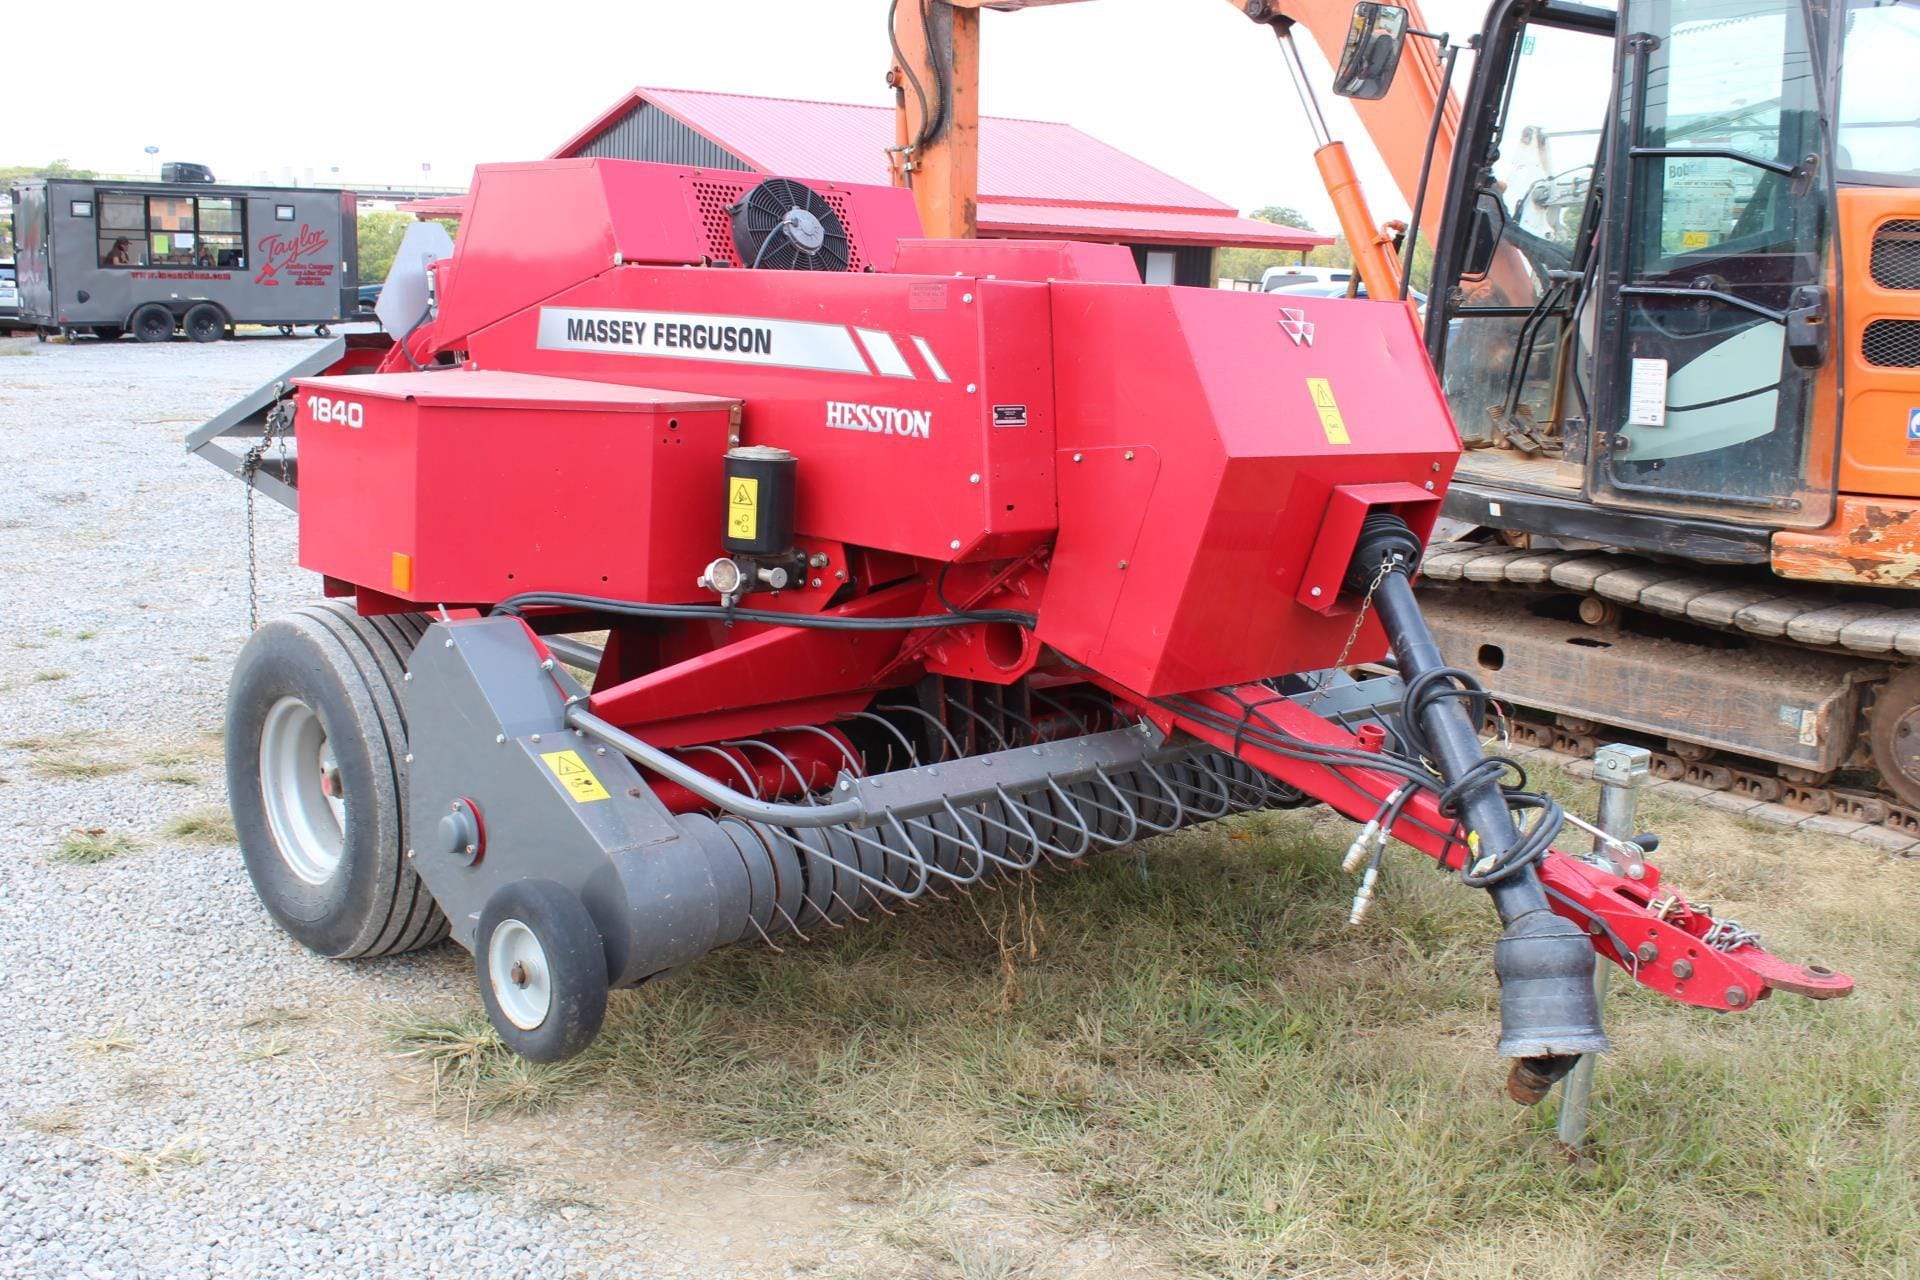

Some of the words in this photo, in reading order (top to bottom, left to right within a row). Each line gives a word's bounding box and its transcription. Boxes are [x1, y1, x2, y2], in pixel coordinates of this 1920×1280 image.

[257, 223, 326, 263] Taylor
[567, 318, 646, 345] MASSEY
[653, 322, 772, 354] FERGUSON
[306, 395, 363, 429] 1840
[825, 400, 932, 439] HESSTON
